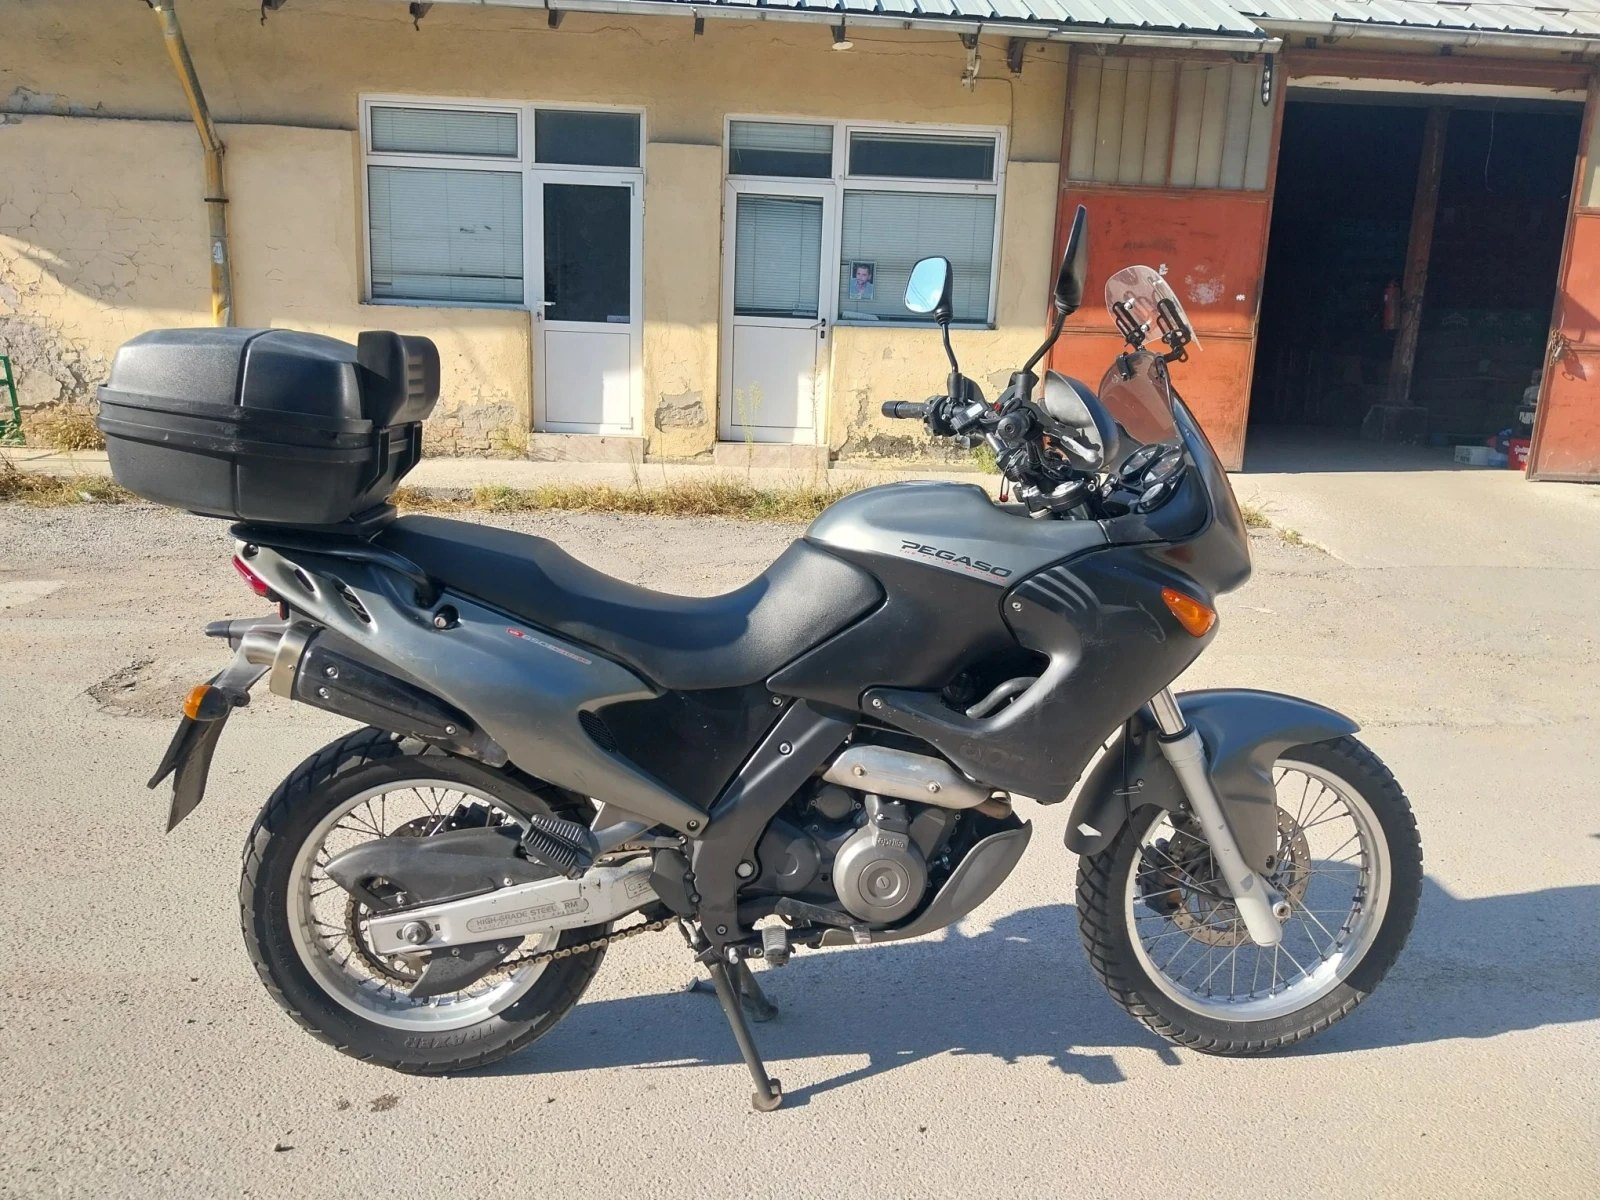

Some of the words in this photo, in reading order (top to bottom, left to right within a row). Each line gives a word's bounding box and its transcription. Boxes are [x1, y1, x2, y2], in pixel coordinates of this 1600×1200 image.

[901, 539, 1012, 578] PEGASO
[476, 910, 528, 926] HIGH-GRADE
[530, 905, 556, 917] STEEL
